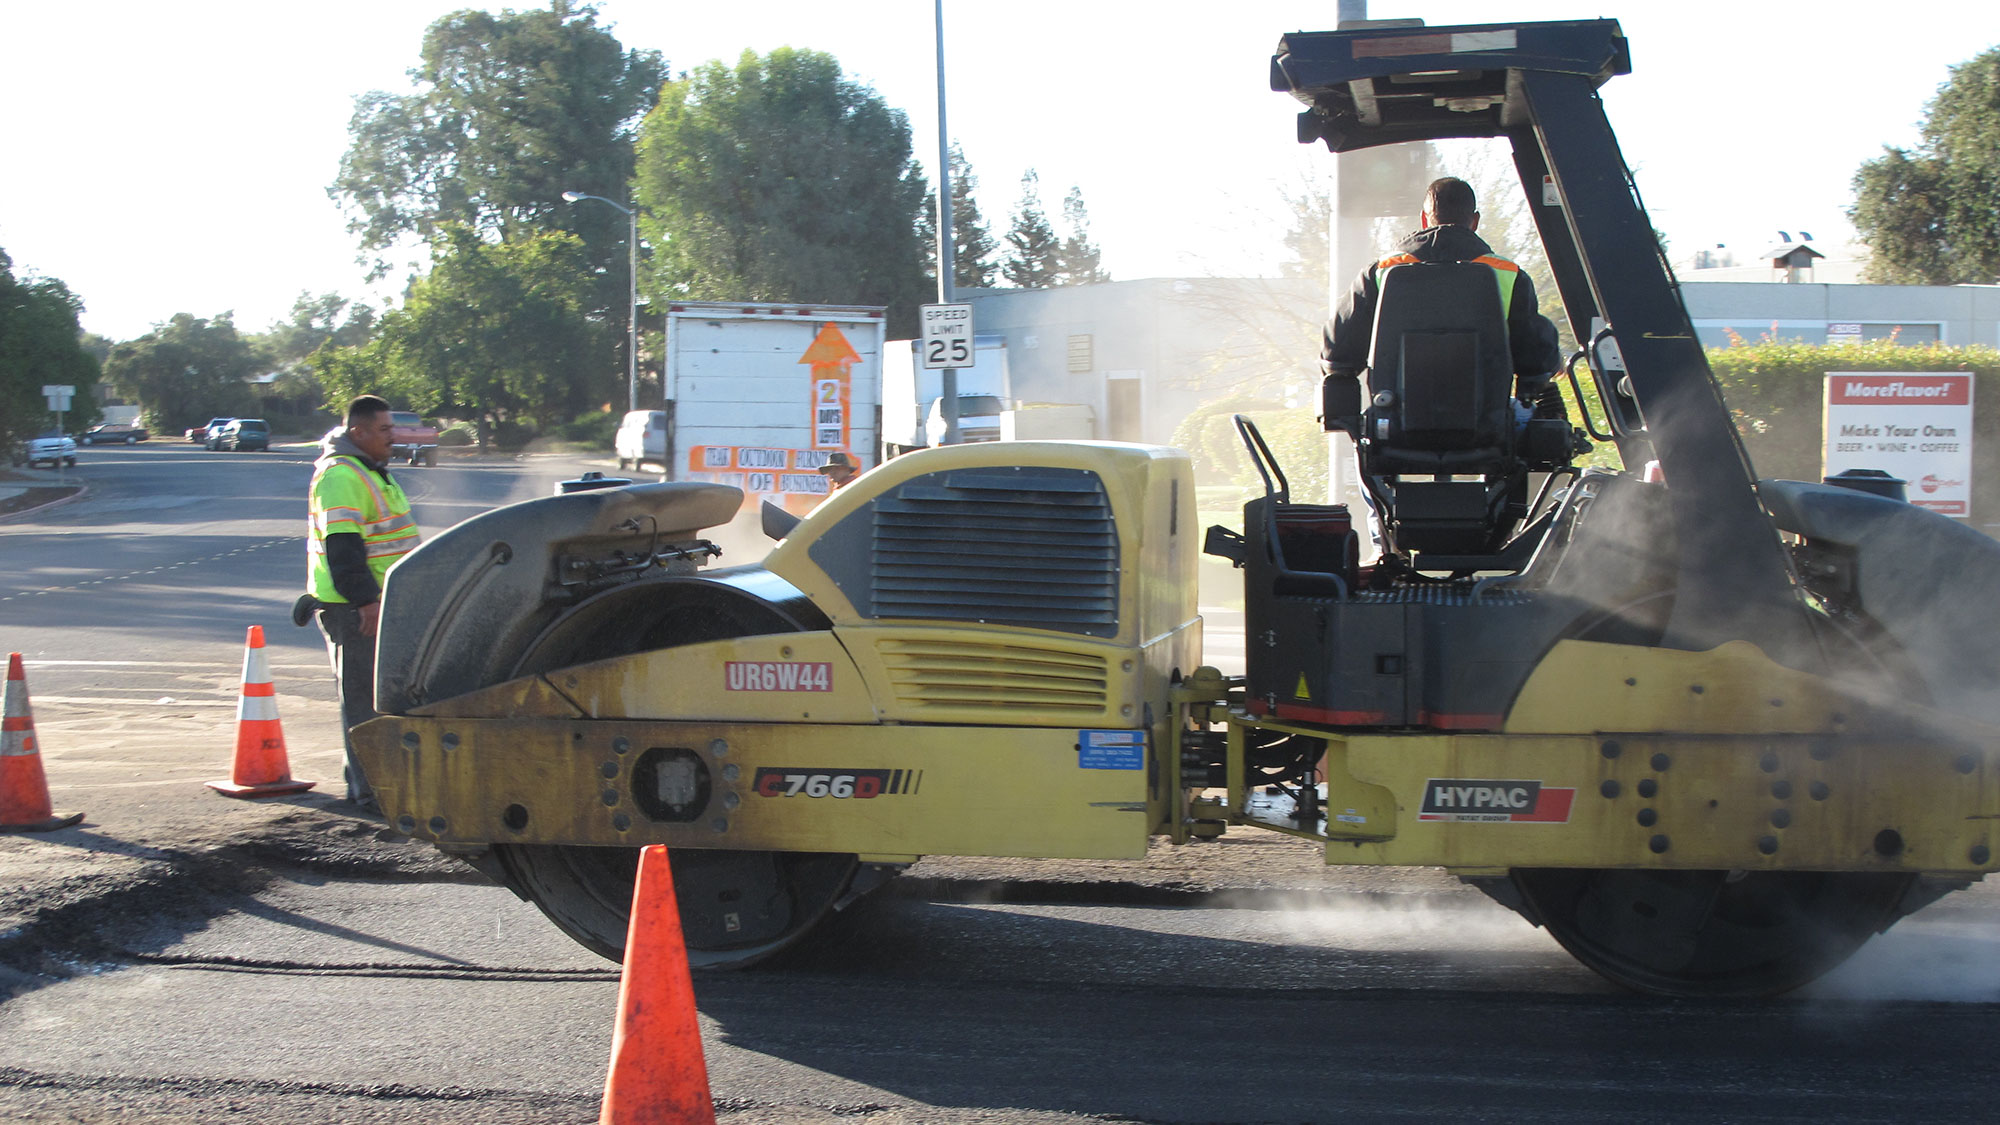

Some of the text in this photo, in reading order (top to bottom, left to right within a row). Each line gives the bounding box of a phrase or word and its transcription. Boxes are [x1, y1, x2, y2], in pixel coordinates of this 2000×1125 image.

[925, 310, 969, 321] SPEED
[931, 324, 964, 335] LIMIT
[929, 339, 968, 362] 25
[821, 382, 837, 403] 2
[1845, 382, 1949, 397] MoreFlavor!
[1840, 425, 1956, 437] Make Your Own
[1837, 442, 1960, 453] BEER WINE COFFEE
[739, 449, 785, 468] OUTDOOR
[750, 474, 772, 491] OF
[780, 475, 828, 493] BUSINESS
[729, 663, 829, 690] UR6W44
[759, 774, 881, 798] C766D
[1434, 786, 1529, 808] HYPAC
